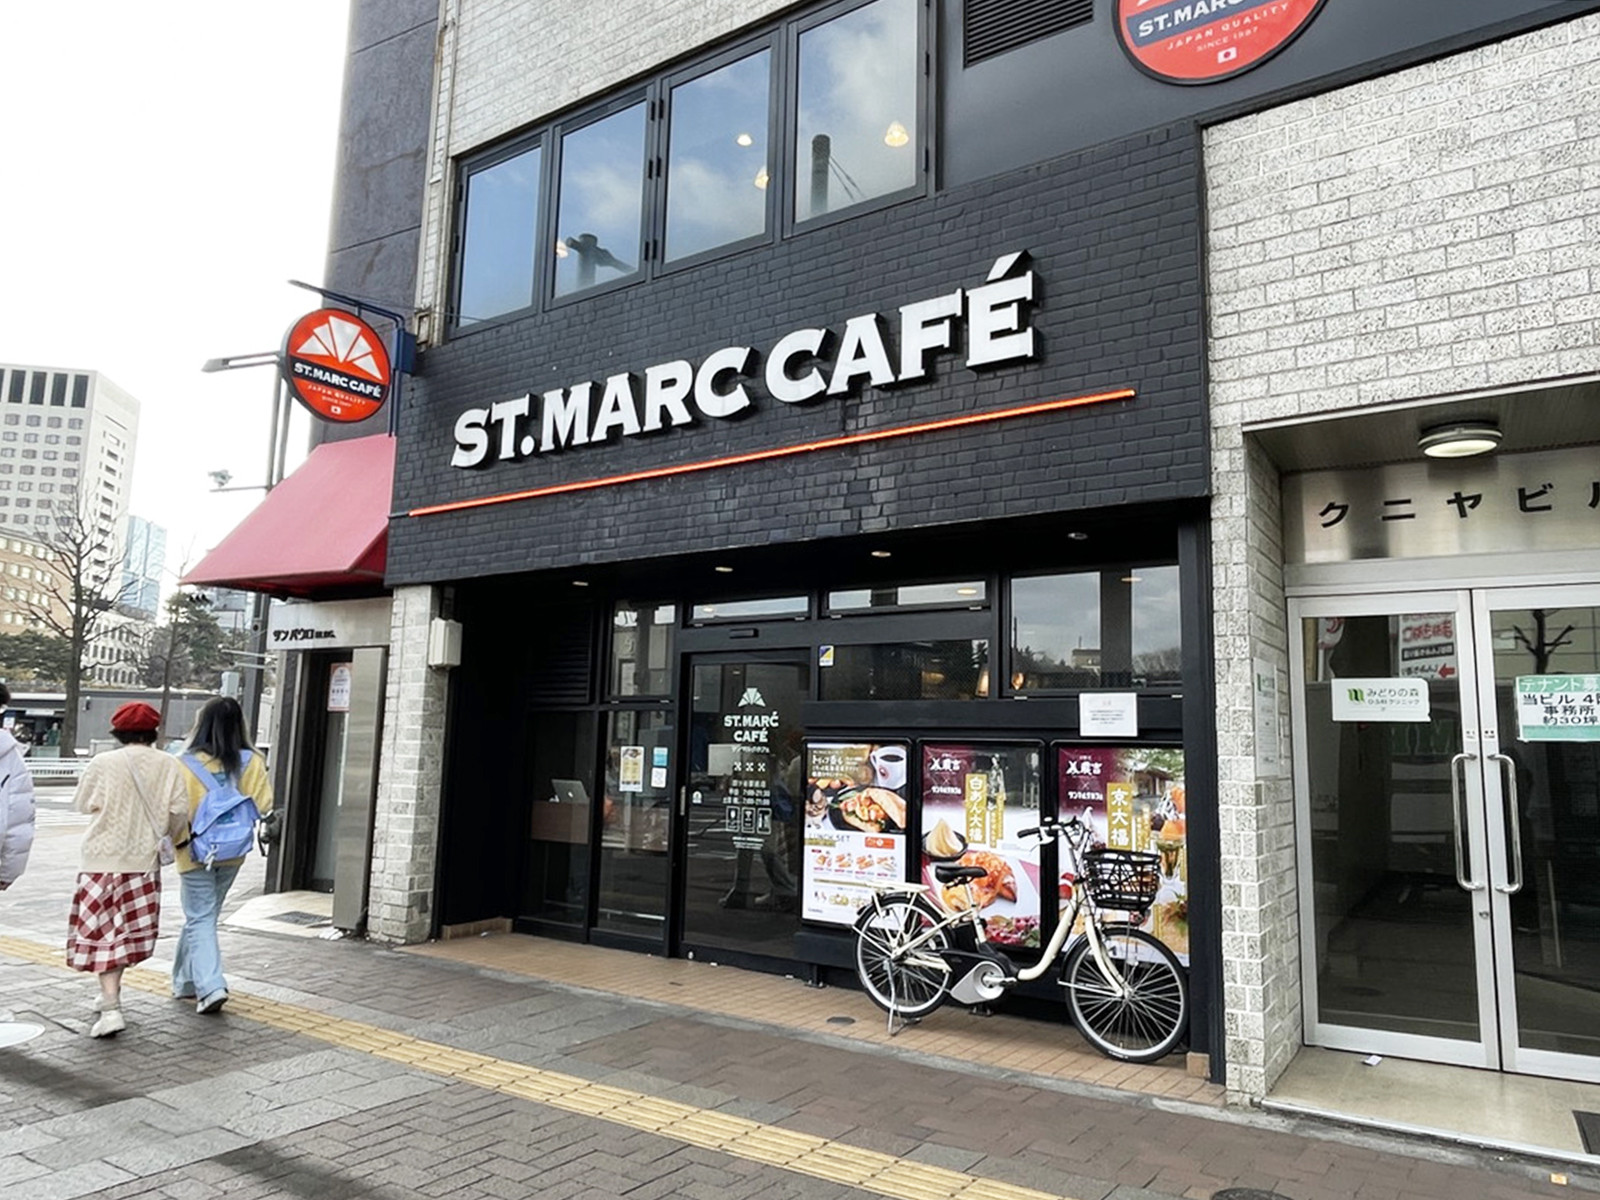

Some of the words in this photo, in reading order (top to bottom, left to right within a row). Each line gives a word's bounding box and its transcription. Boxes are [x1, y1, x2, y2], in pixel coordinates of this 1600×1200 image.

[1167, 28, 1214, 51] JAPAN
[1221, 3, 1289, 32] QUALITY
[1197, 36, 1229, 52] SINCE
[450, 346, 752, 469] ST.MARC
[764, 248, 1037, 403] CAFÉ
[294, 362, 348, 388] ST.MARC
[348, 380, 382, 398] CAFÉ
[1366, 688, 1419, 697] みどりの森
[1543, 705, 1595, 717] 事務所
[733, 727, 769, 743] CAFÉ
